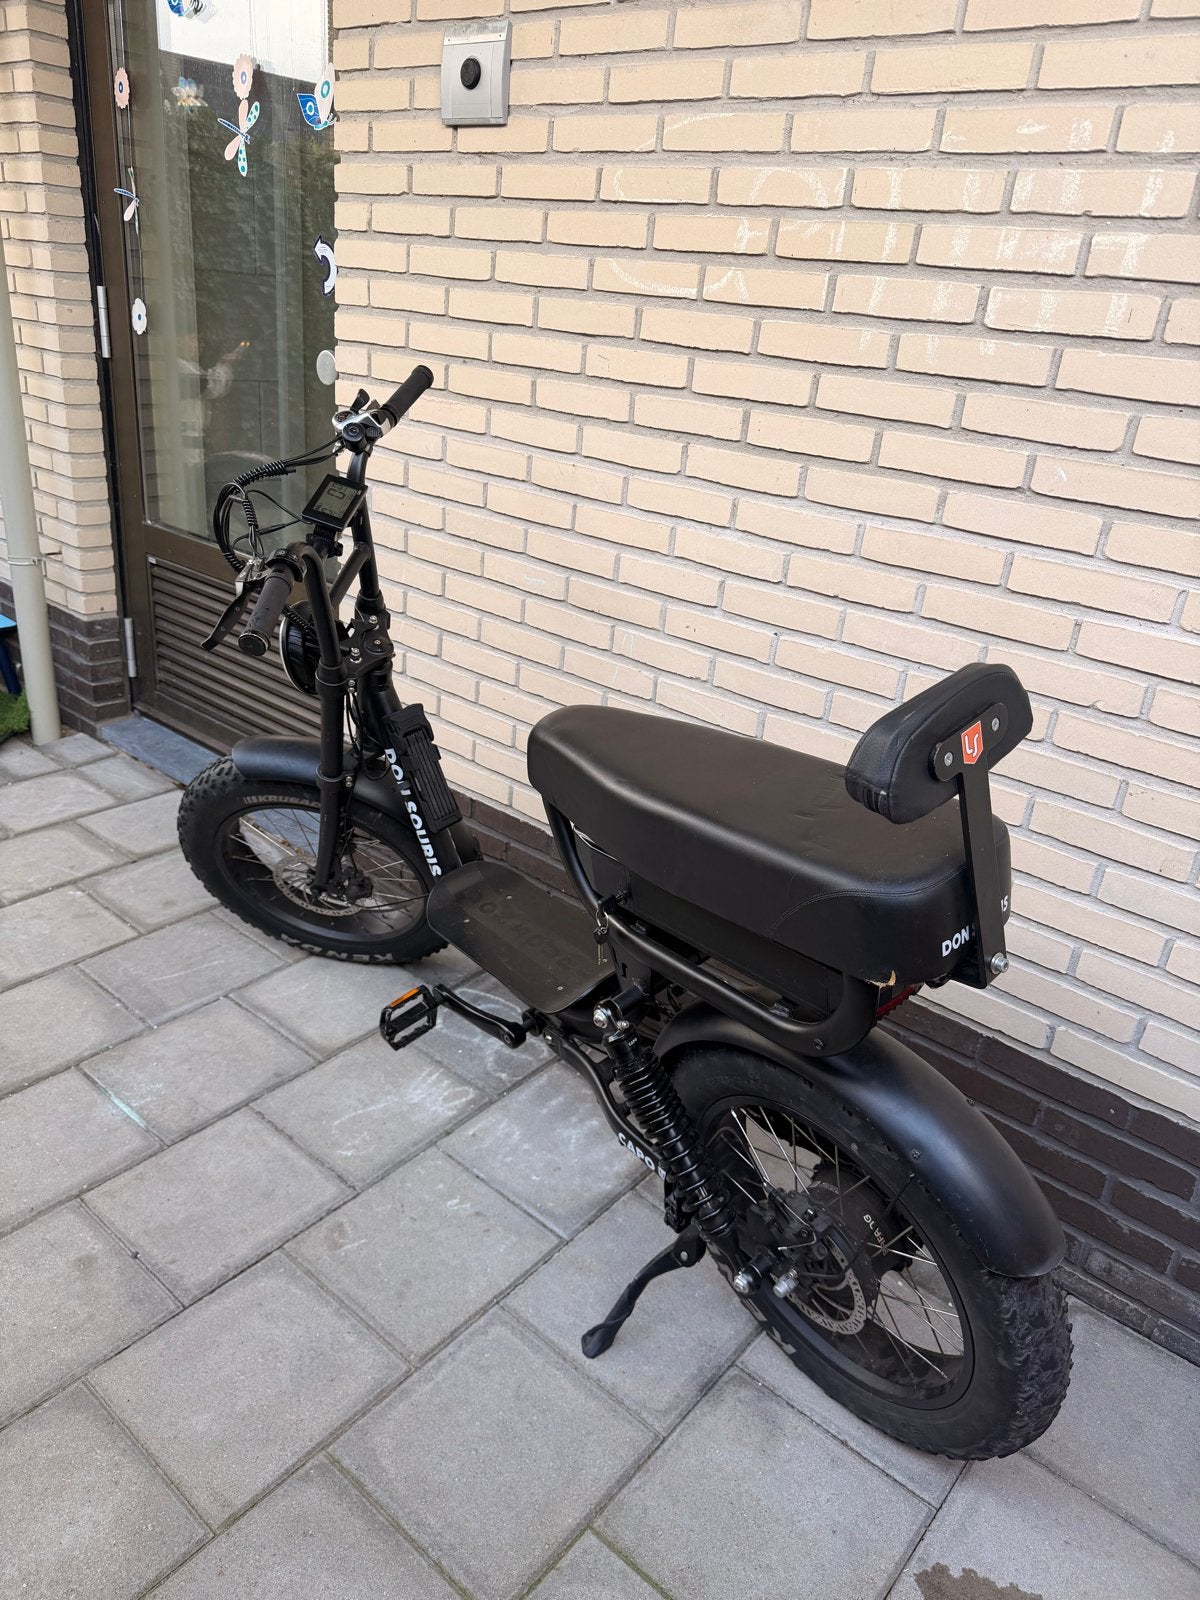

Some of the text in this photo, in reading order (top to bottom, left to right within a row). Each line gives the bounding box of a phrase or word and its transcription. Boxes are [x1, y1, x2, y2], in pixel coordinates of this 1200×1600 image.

[257, 794, 321, 809] KRUSAD
[404, 801, 442, 877] SOURIS
[941, 925, 970, 957] DON
